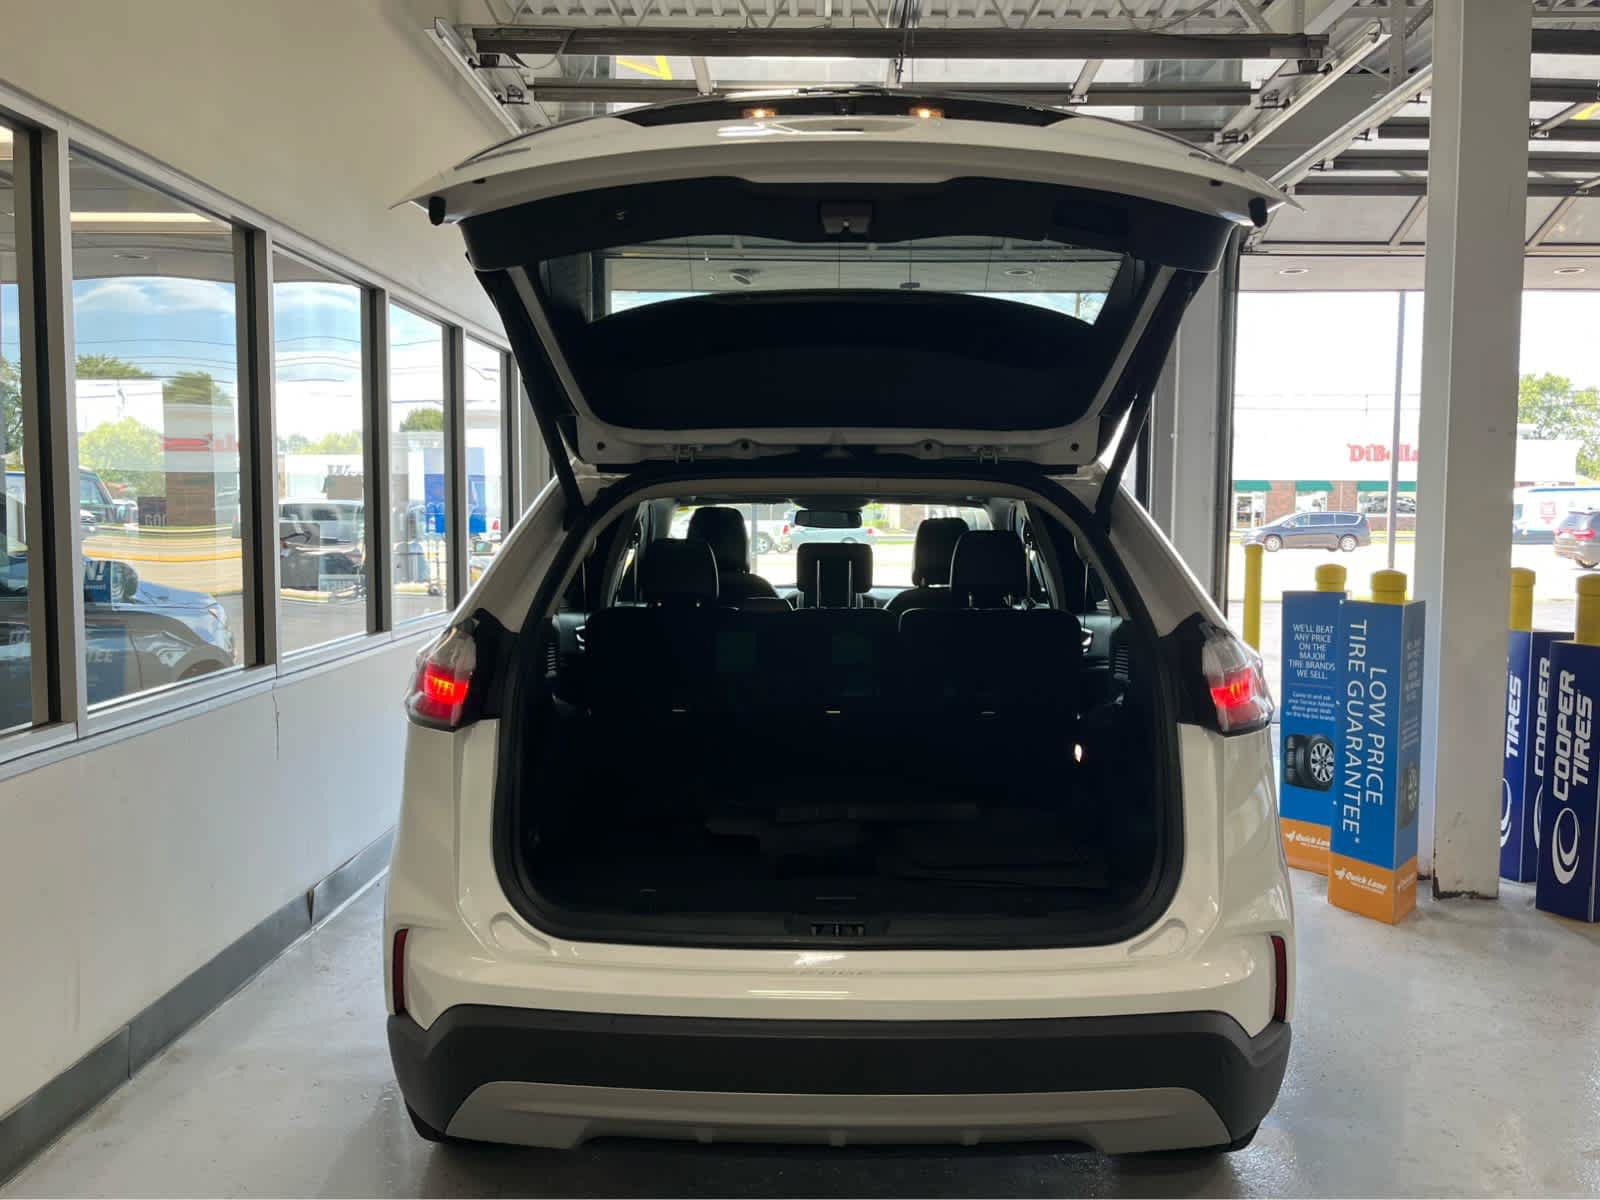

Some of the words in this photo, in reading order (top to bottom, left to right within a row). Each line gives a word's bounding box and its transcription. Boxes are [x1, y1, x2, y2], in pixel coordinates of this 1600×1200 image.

[1294, 633, 1310, 641] ANY
[1311, 634, 1331, 644] PRICE
[1299, 642, 1311, 650] ON
[1313, 643, 1327, 652] THE
[1299, 651, 1326, 660] MAJOR
[1316, 624, 1334, 634] BEAT
[1348, 619, 1368, 673] TIRE
[1288, 659, 1304, 669] TIRE
[1305, 660, 1336, 671] BRANDS
[1296, 669, 1308, 679] WE
[1368, 666, 1387, 727] LOW
[1505, 674, 1522, 759] TIRES
[1534, 657, 1550, 777] COOPER
[1553, 669, 1576, 802] COOPER
[1572, 693, 1593, 786] TIRES
[1365, 732, 1385, 806] PRICE
